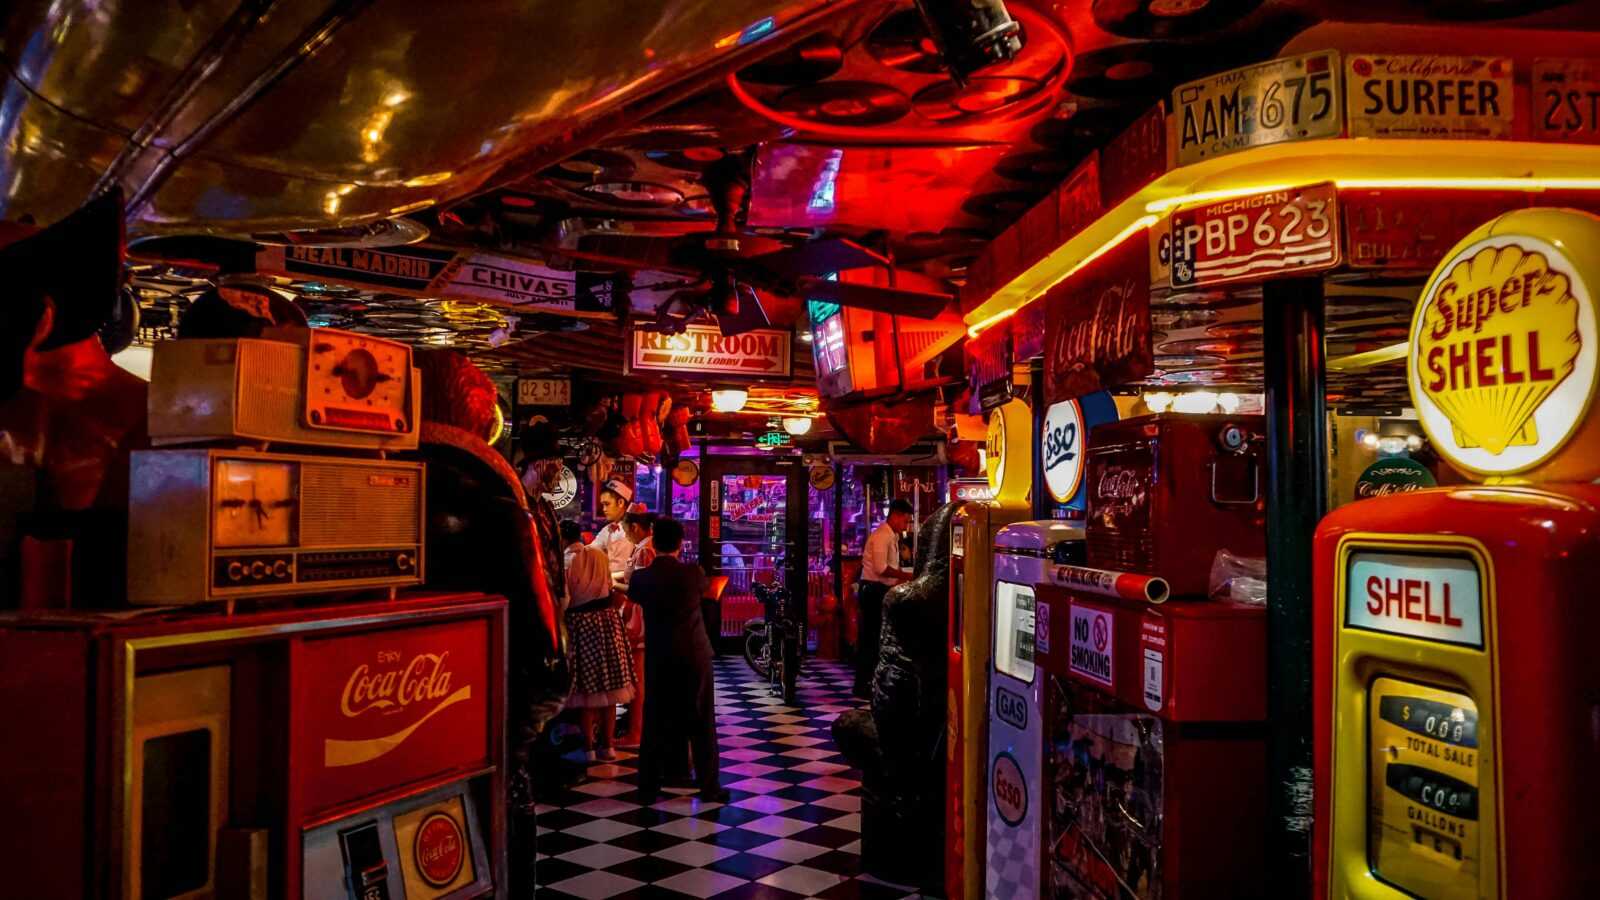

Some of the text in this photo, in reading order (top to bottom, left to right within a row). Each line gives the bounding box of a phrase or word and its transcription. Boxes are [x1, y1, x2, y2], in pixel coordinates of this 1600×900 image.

[1386, 56, 1472, 77] California
[1182, 73, 1331, 149] AAM 675
[1363, 79, 1500, 115] SURFER
[1420, 126, 1448, 134] USA
[1206, 192, 1289, 216] MICHIGAN
[292, 247, 347, 267] REAL
[352, 250, 430, 278] MADRID
[1174, 261, 1192, 282] 76
[472, 263, 568, 296] CHIVAS
[641, 331, 778, 357] RESTROOM
[673, 355, 740, 366] HOTEL LOBBY
[1428, 331, 1554, 393] SHELL
[1366, 575, 1462, 627] SHELL
[1074, 616, 1089, 643] NO
[1072, 644, 1110, 677] SMOKING
[341, 651, 452, 717] Coca-Cola
[1000, 694, 1024, 722] GAS
[1401, 705, 1411, 721] $
[1407, 736, 1473, 767] TOTAL SALE
[1408, 806, 1465, 838] GALLONS
